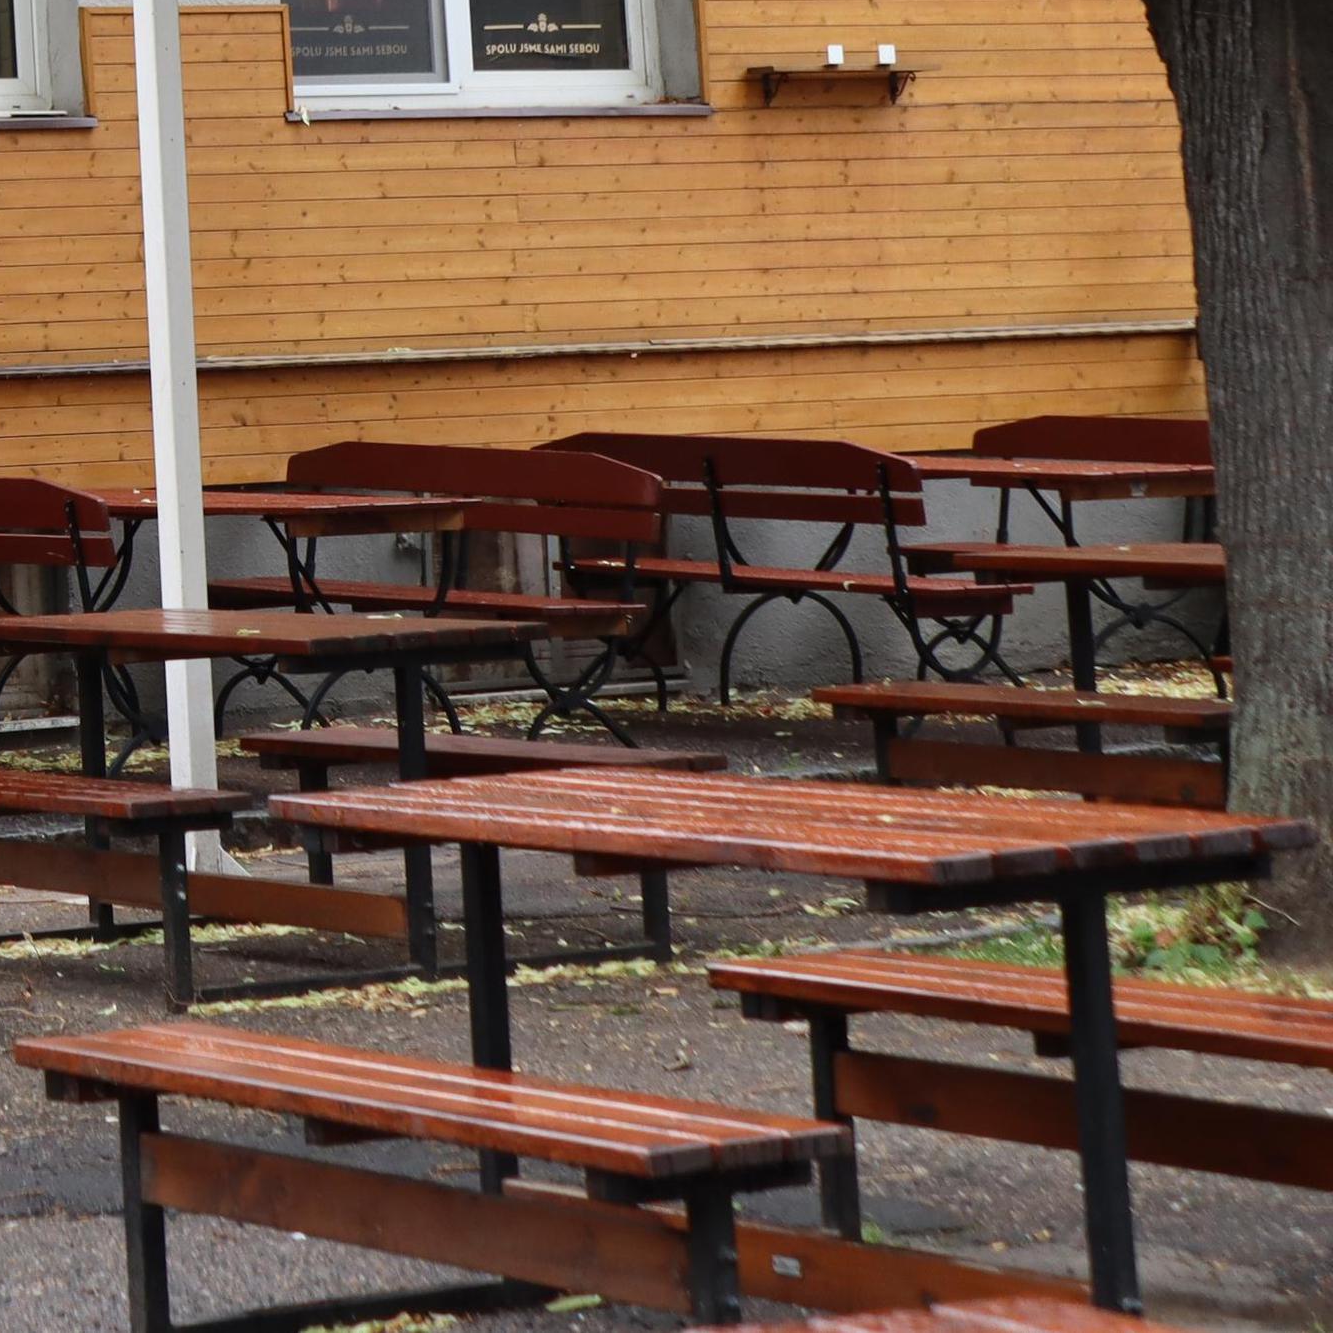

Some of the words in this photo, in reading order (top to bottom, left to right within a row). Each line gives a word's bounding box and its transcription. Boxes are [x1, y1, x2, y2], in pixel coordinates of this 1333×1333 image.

[325, 46, 348, 57] JSME
[350, 46, 374, 56] SAMI
[375, 44, 408, 56] SEBOU
[485, 43, 517, 56] SPOLU
[519, 43, 542, 53] JSME
[544, 43, 567, 54] SAMI
[569, 43, 600, 54] SEBOU
